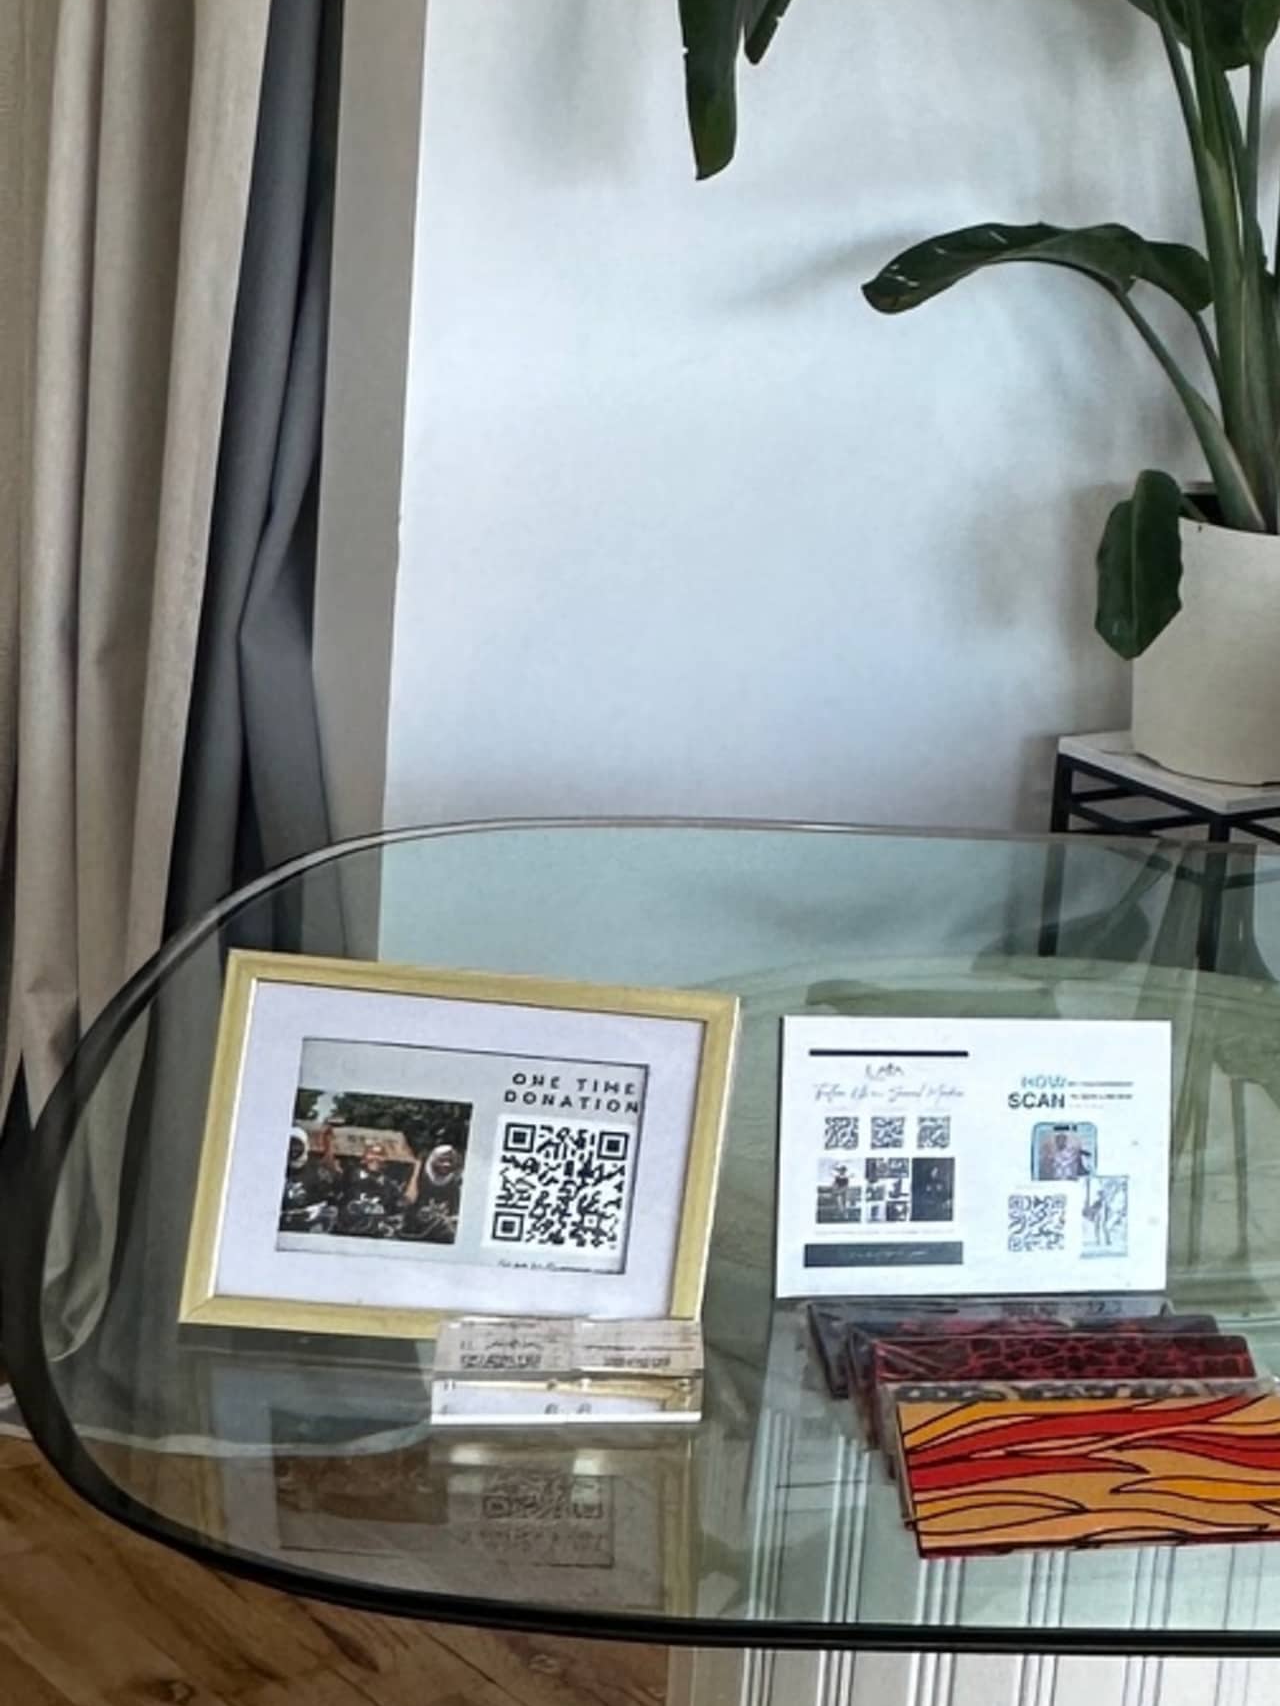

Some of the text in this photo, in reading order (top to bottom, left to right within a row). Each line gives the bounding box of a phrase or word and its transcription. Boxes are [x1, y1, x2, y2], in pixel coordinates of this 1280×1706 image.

[512, 1073, 635, 1095] ONE TIME
[504, 1090, 639, 1113] DONATION
[1008, 1093, 1065, 1108] SCAN
